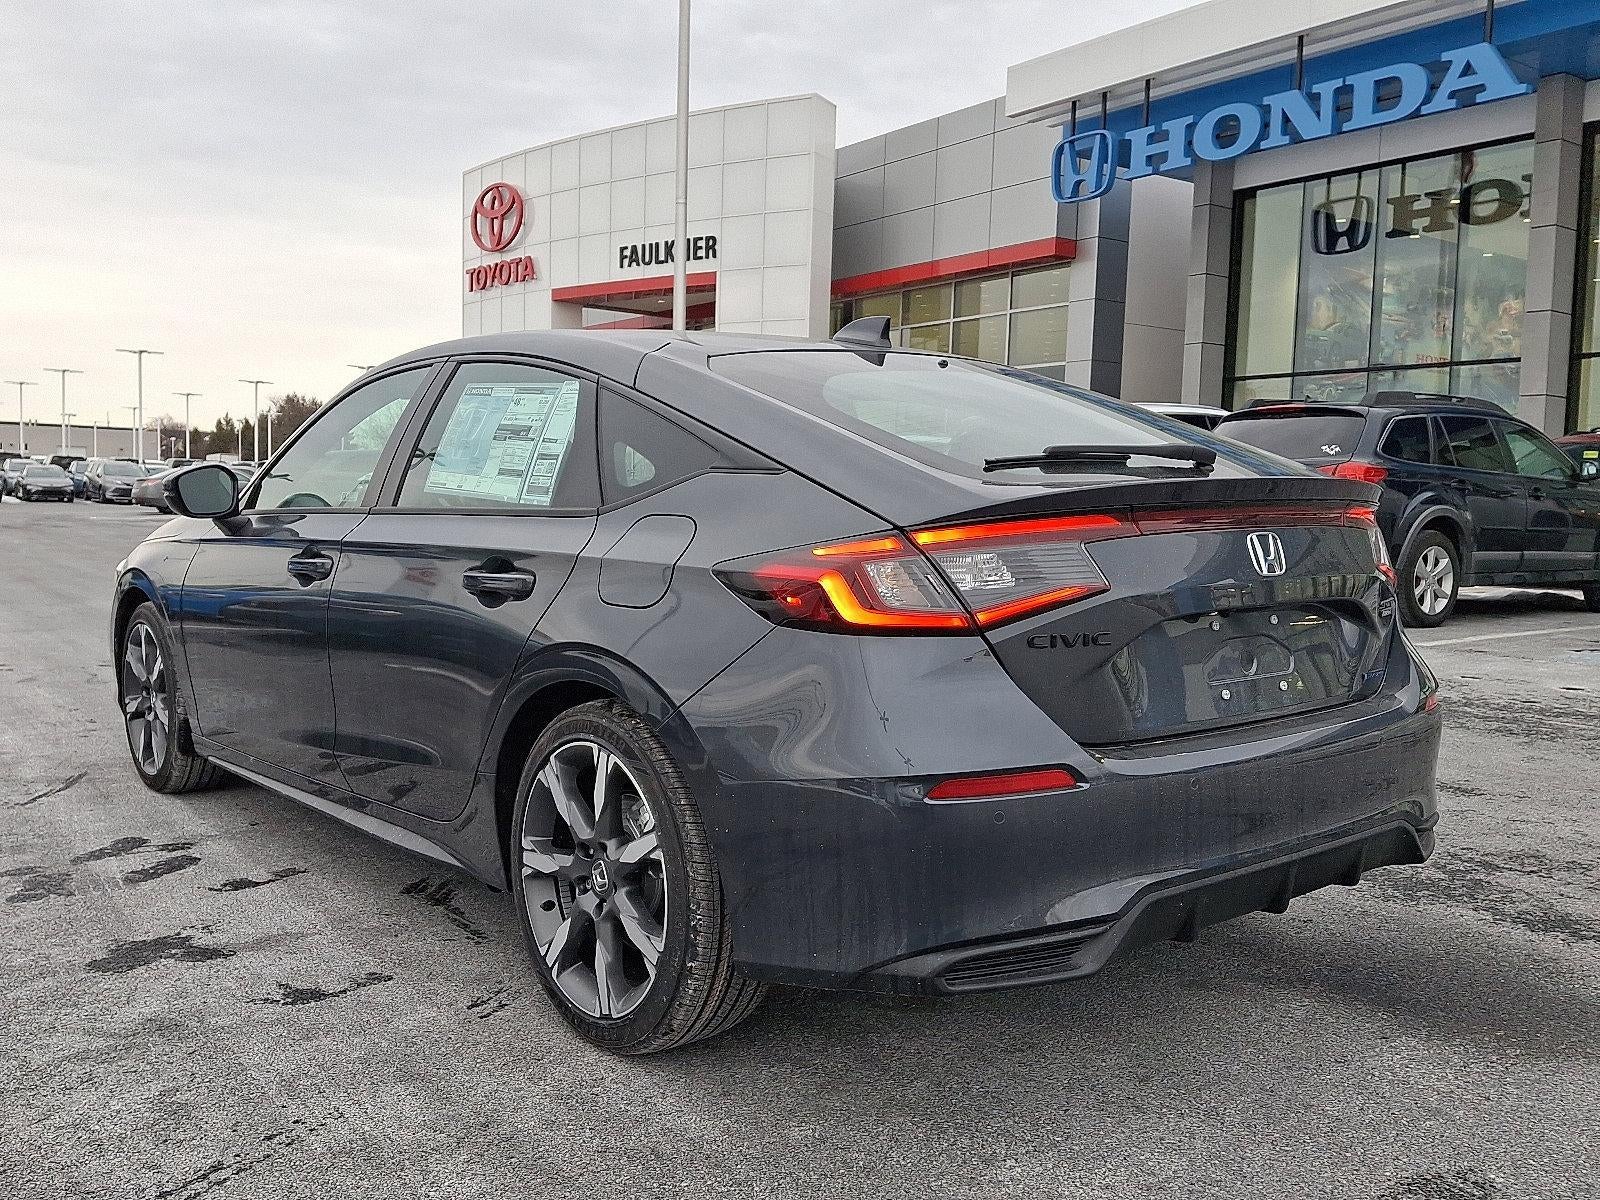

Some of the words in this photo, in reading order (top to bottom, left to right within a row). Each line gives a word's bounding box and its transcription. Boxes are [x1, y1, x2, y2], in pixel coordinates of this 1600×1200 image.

[1123, 43, 1531, 180] HONDA
[1385, 173, 1533, 238] HO
[466, 255, 536, 292] TOYOTA
[1026, 631, 1112, 649] CIVIC
